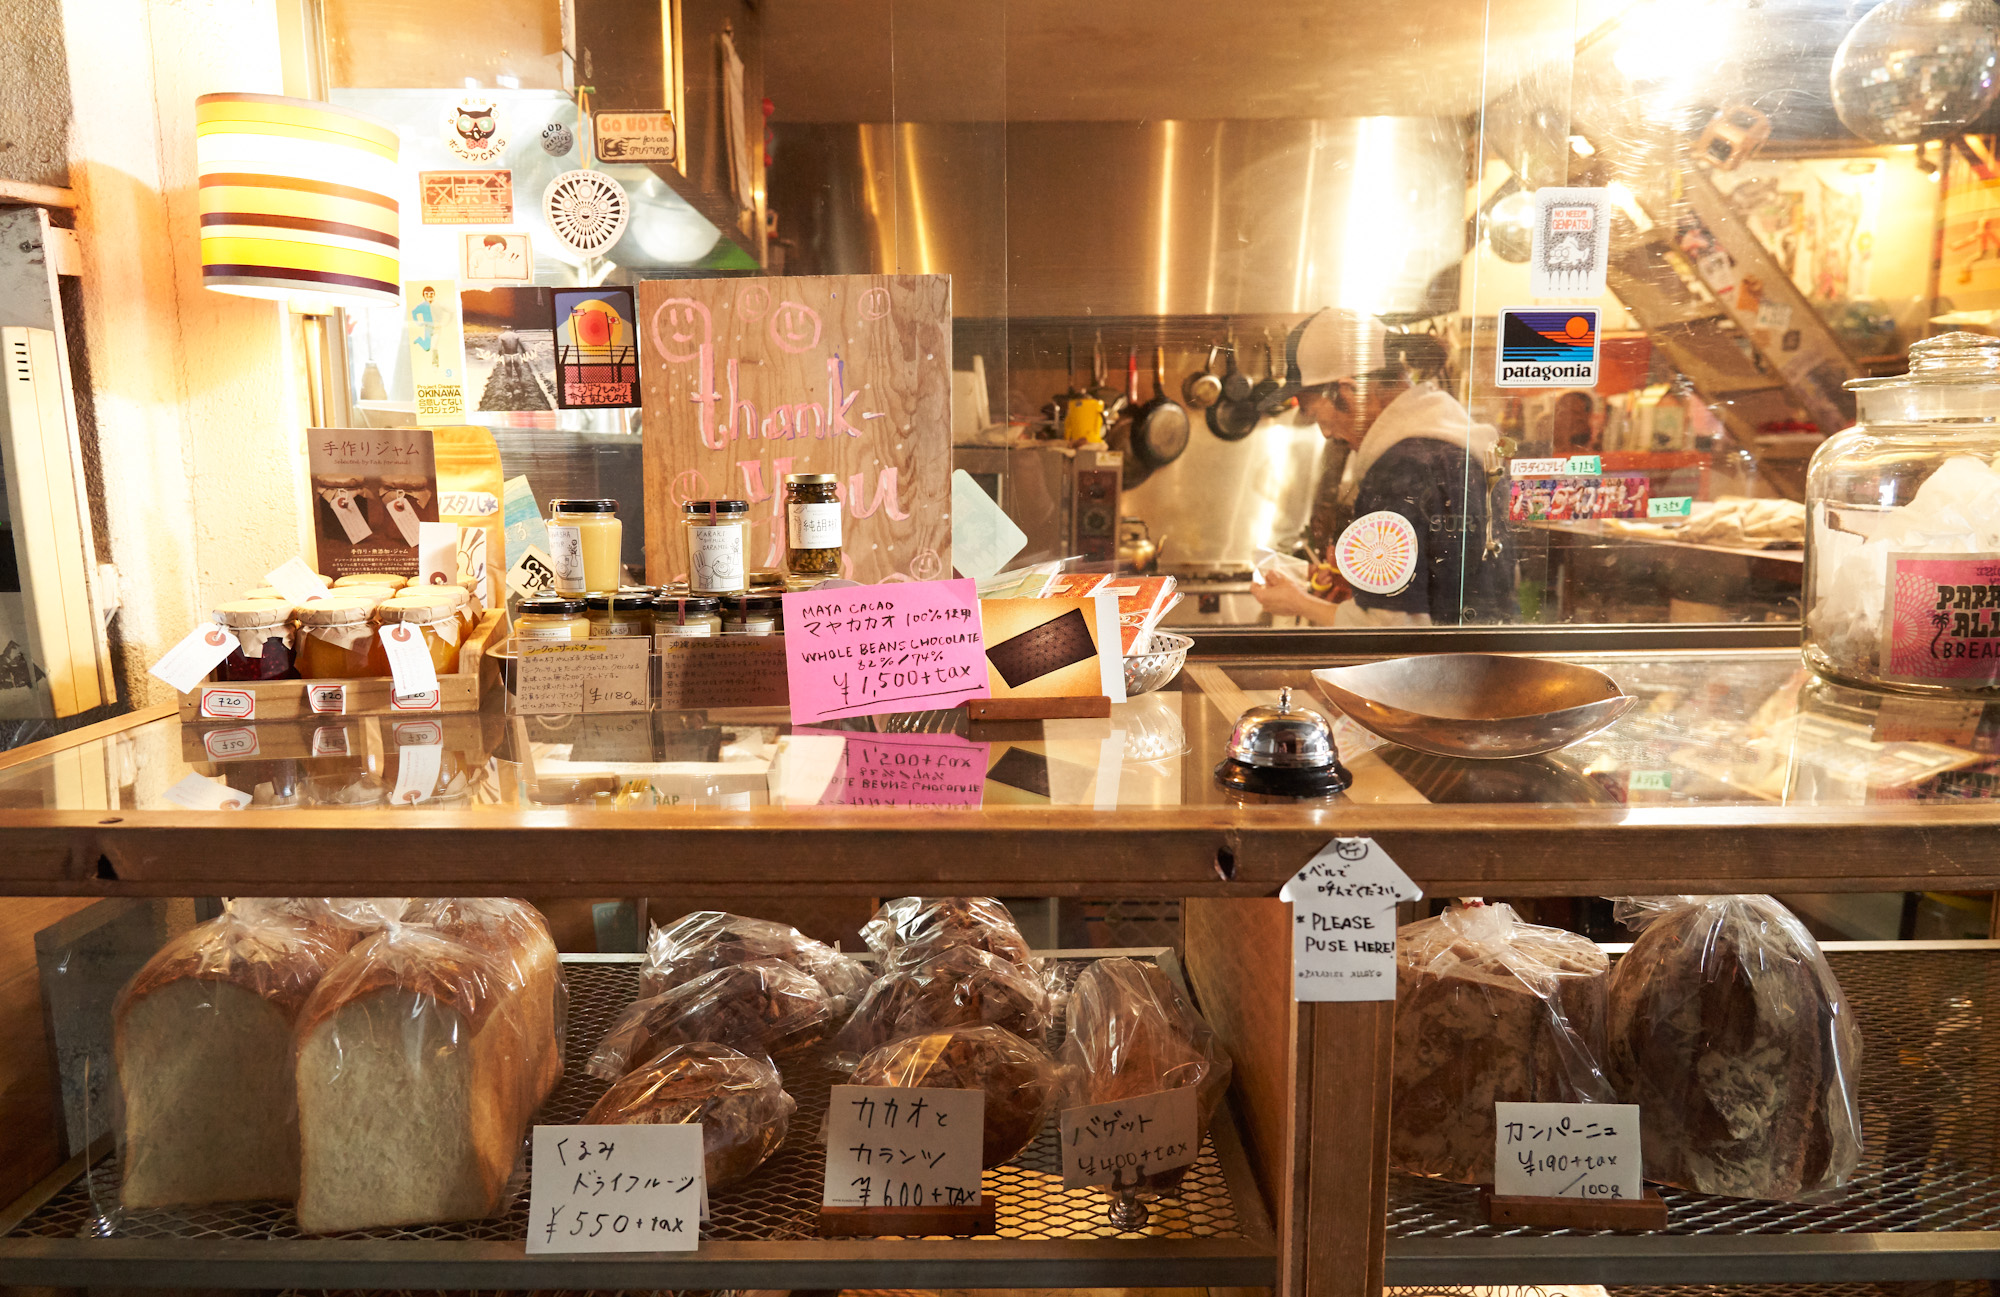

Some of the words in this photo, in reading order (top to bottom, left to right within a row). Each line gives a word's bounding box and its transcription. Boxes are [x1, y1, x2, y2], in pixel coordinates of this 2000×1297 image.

[542, 123, 562, 138] GOD
[600, 117, 622, 132] GO
[626, 116, 671, 132] VOTE
[1554, 209, 1564, 218] NO
[1502, 363, 1592, 382] patagonia
[417, 389, 462, 398] OKINAWA
[419, 406, 463, 415] プロジェクト
[322, 440, 420, 457] 手作りジャム
[802, 603, 843, 619] MAYA
[848, 601, 895, 615] CACAO
[803, 614, 897, 638] マヤカカオ
[905, 608, 972, 628] 100%使用
[802, 645, 852, 664] WHOLE
[858, 640, 906, 656] BEANS
[909, 633, 981, 649] CHOCOLATE
[218, 697, 241, 708] 720
[321, 692, 342, 701] 720
[588, 687, 633, 705] ¥1180
[1309, 863, 1351, 878] ベルで
[1312, 912, 1376, 931] PLEASE
[1305, 936, 1349, 952] PUSE
[1354, 940, 1395, 959] HERE!
[851, 1096, 949, 1129] カカオと
[1073, 1109, 1153, 1147] バゲット
[1505, 1116, 1617, 1145] カンパーニュ
[556, 1138, 615, 1166] くるみ
[849, 1142, 946, 1169] カランツ
[573, 1169, 696, 1197] ドライフルーツ
